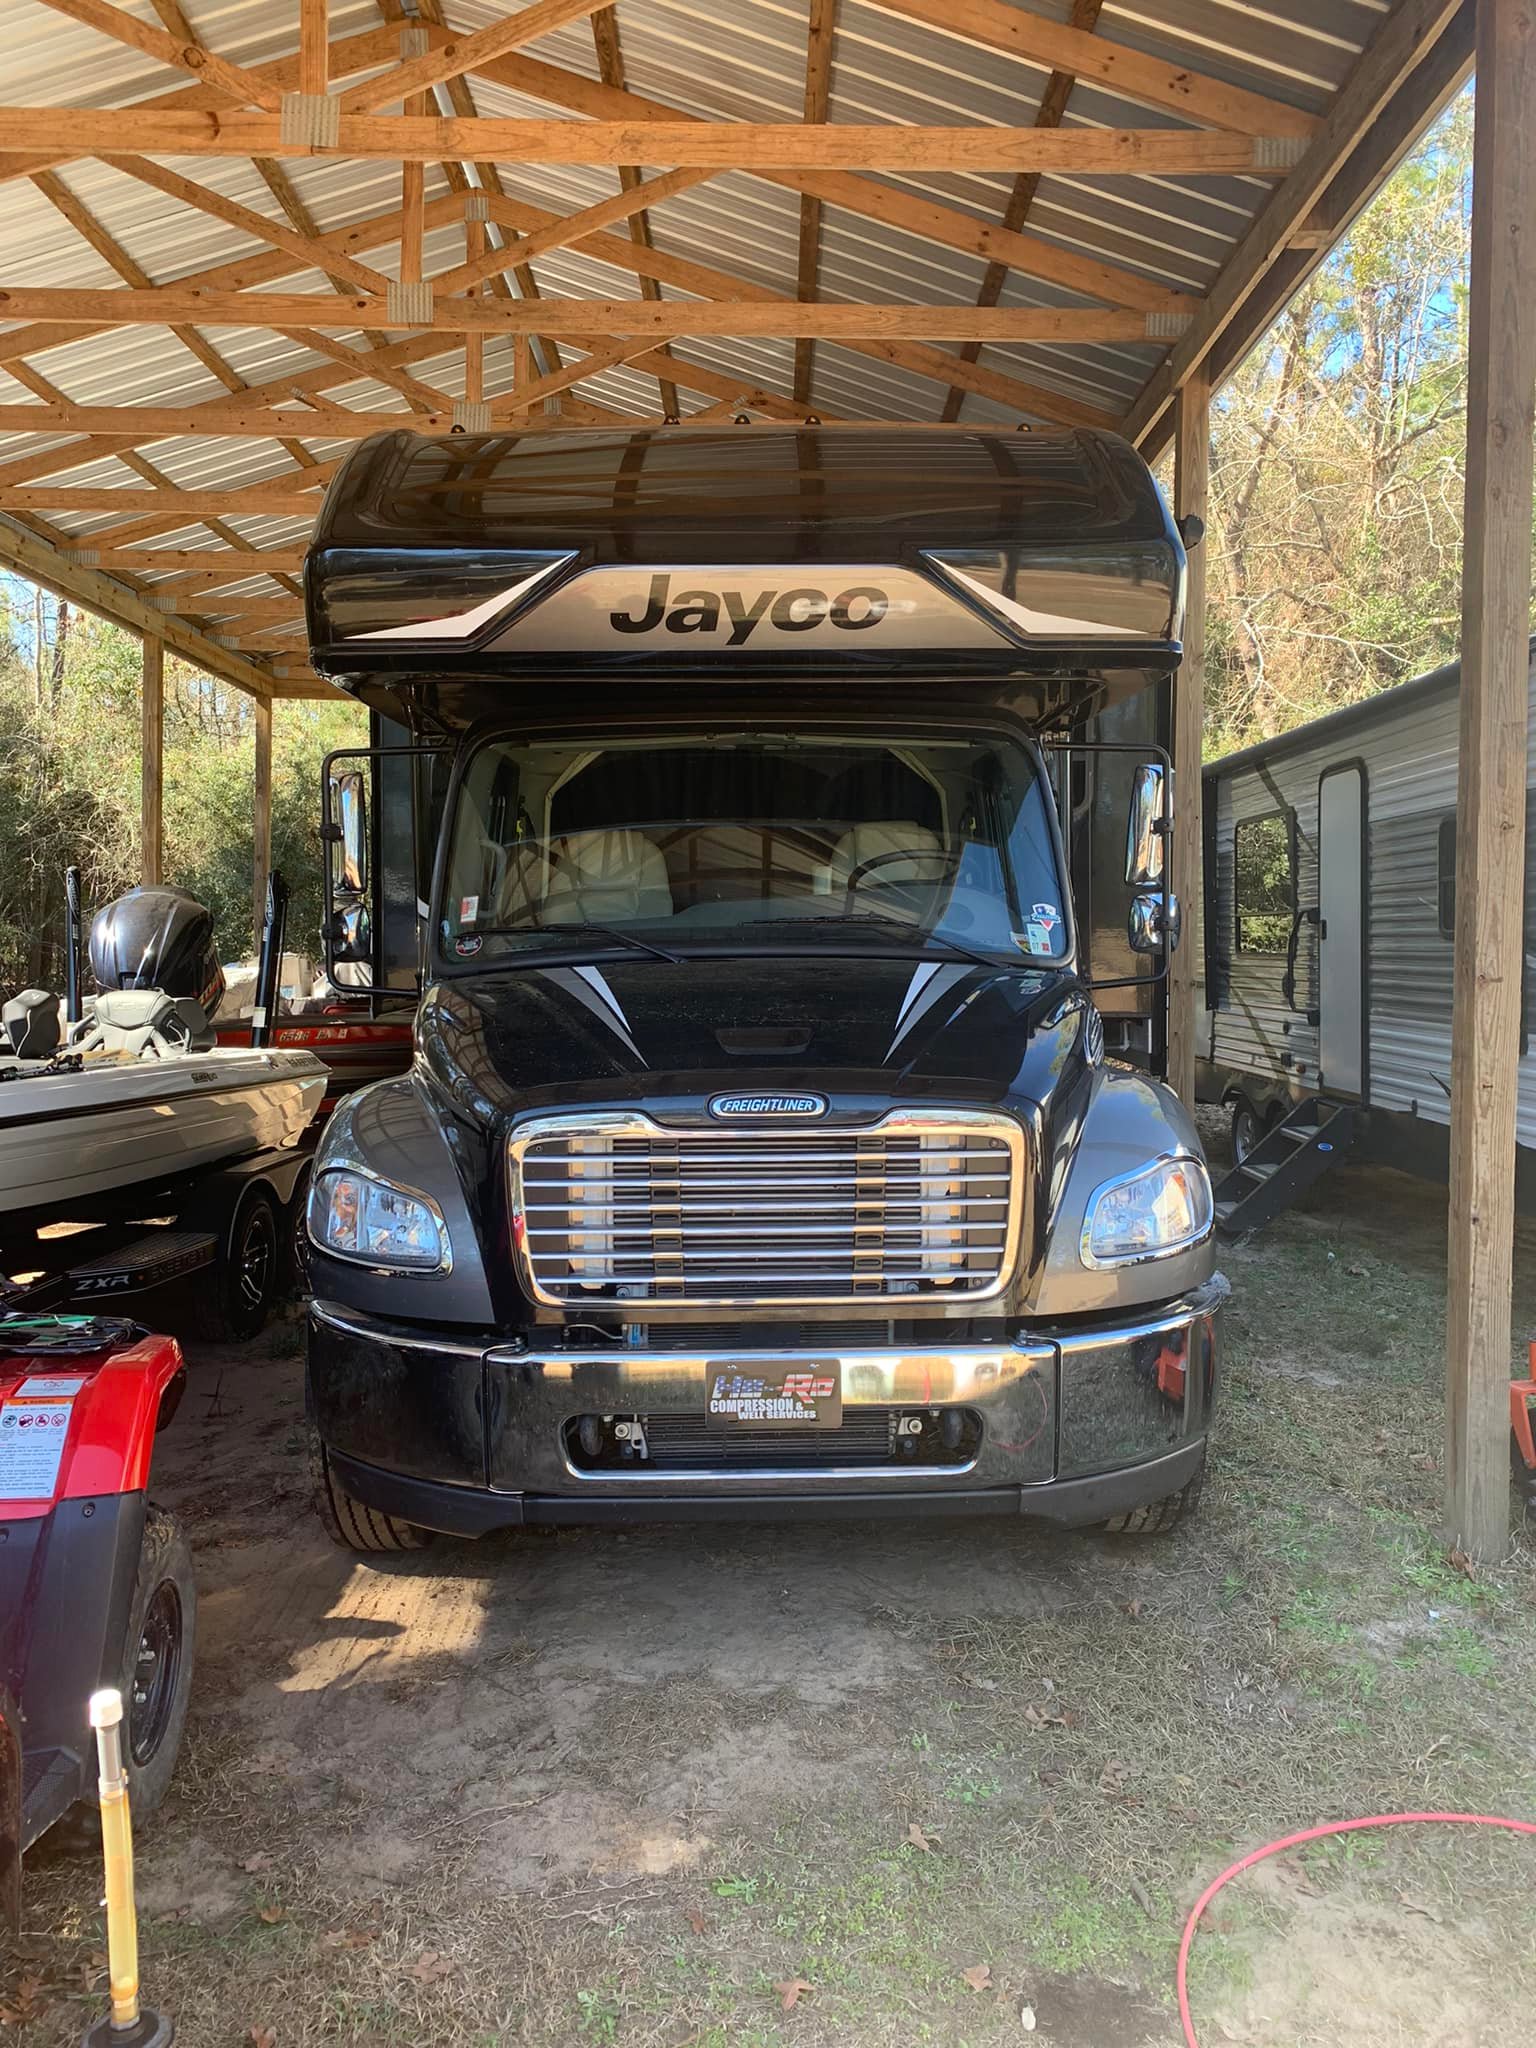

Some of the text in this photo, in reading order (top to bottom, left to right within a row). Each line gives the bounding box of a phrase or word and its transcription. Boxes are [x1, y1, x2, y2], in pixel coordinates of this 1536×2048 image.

[610, 574, 889, 645] Jayco
[722, 1098, 813, 1112] FREIGHTLINER
[710, 1398, 804, 1413] COMPRESSION &
[737, 1410, 817, 1420] WELL SERVICES
